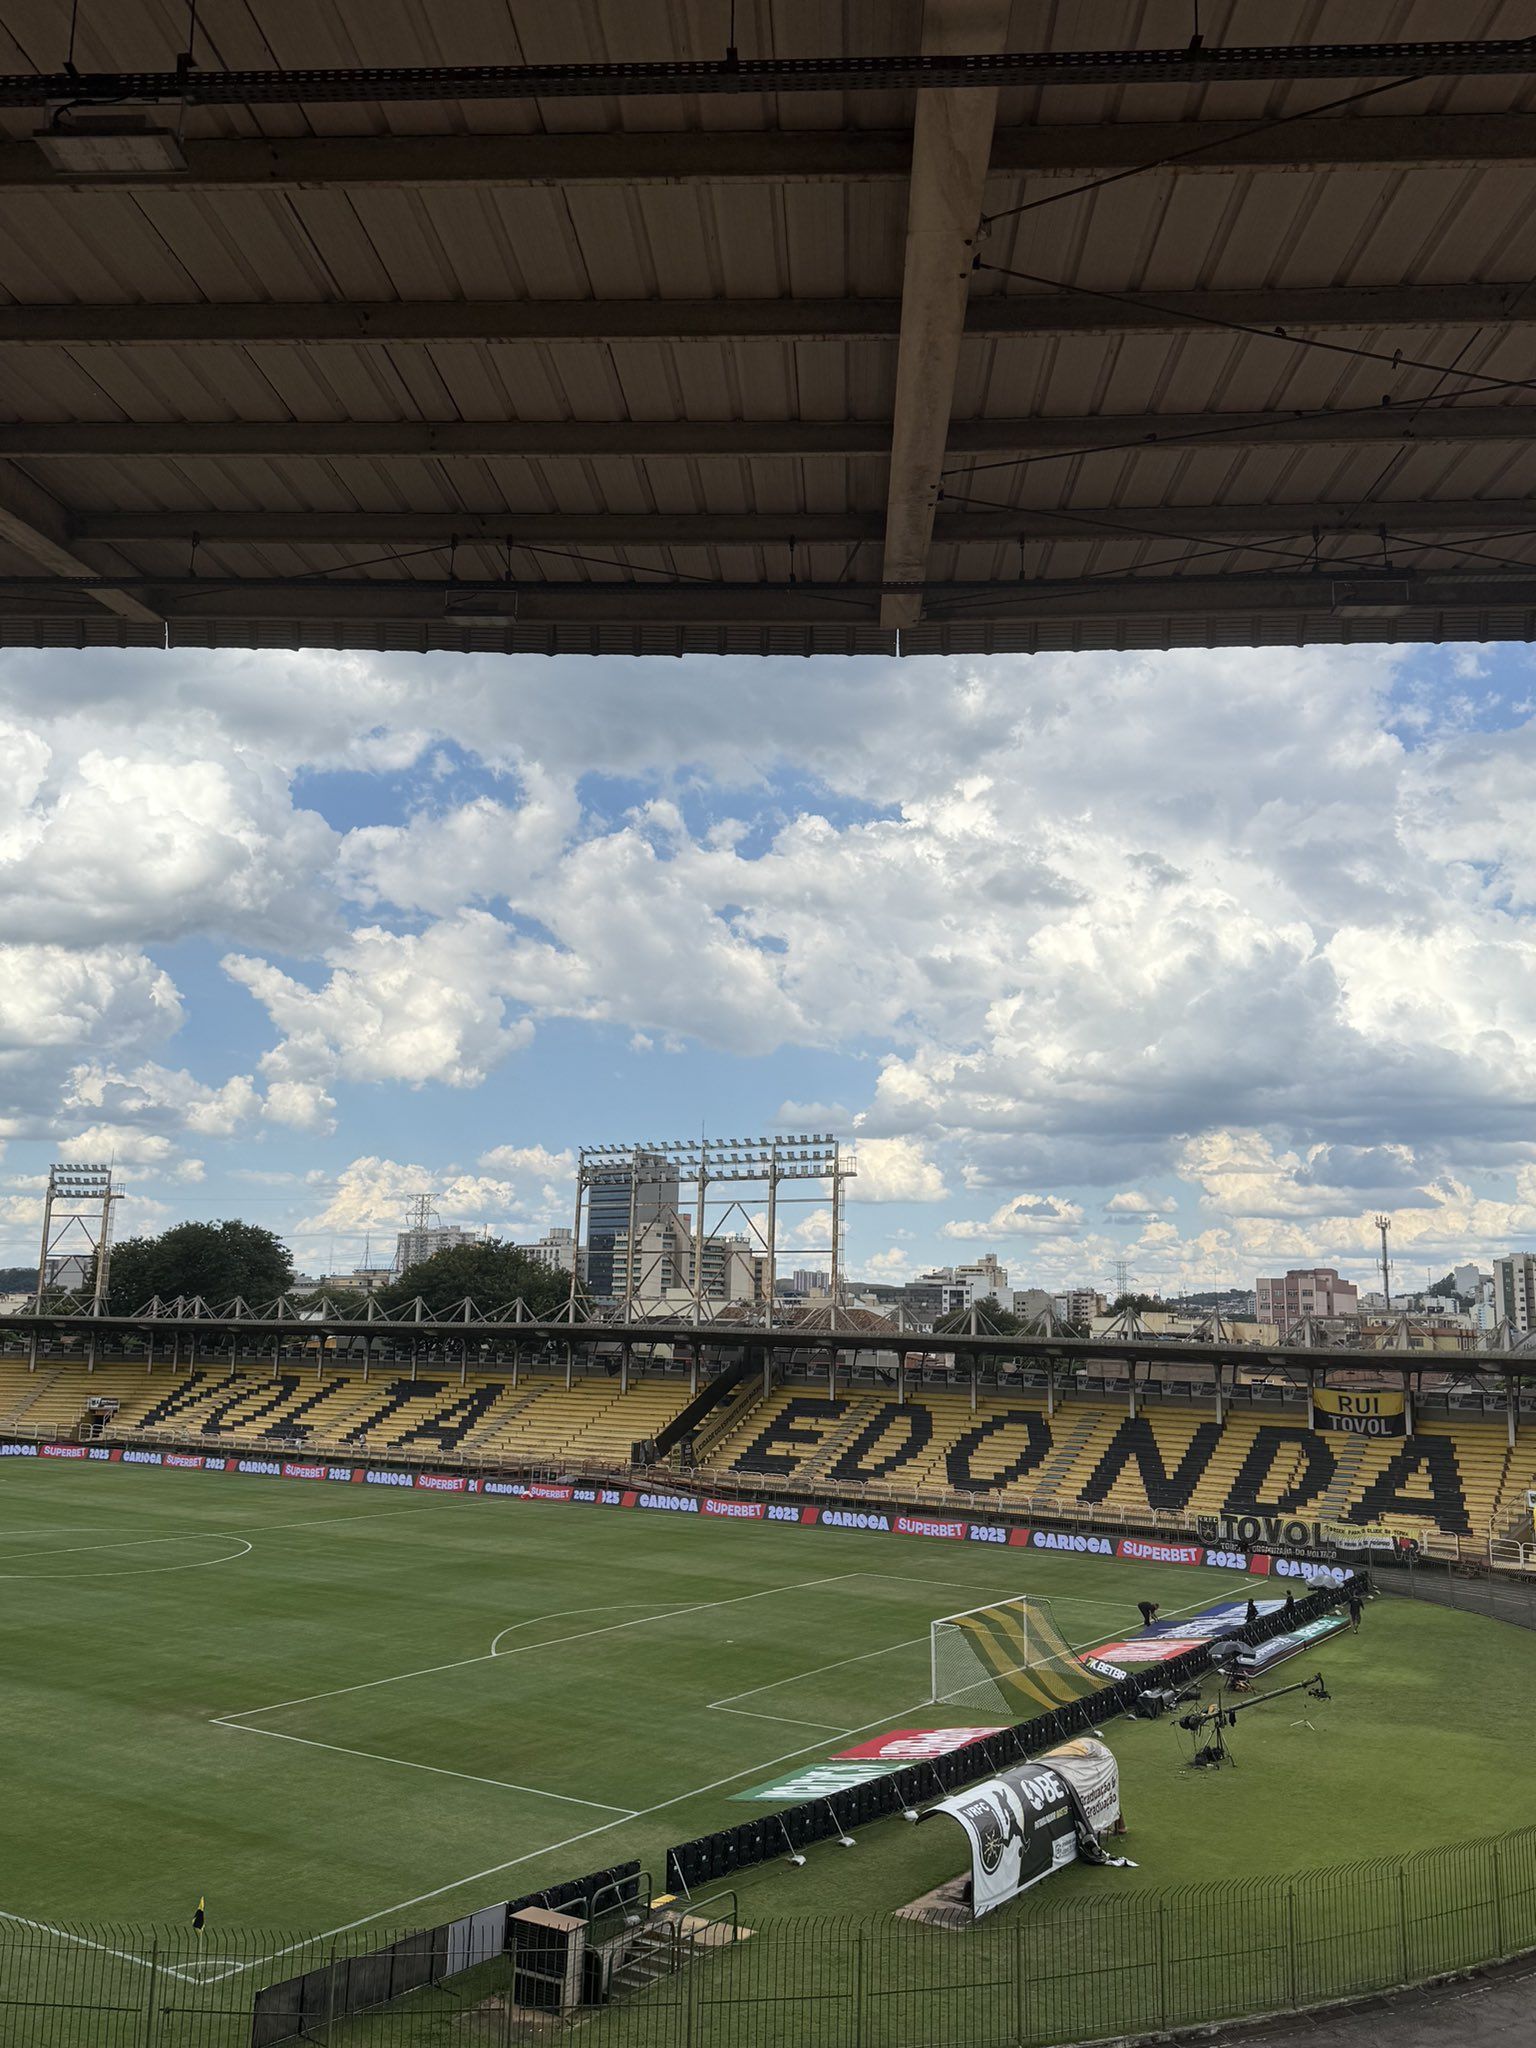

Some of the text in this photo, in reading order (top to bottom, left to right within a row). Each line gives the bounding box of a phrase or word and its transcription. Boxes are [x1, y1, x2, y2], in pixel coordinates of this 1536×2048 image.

[1338, 1395, 1379, 1414] RUI
[1328, 1414, 1392, 1435] TOVOL
[43, 1445, 86, 1458] SUPERBET
[89, 1448, 110, 1460] 2025
[123, 1451, 225, 1470] CARIOCA SUPERBET 2025
[239, 1460, 351, 1481] CARIOCA SUPERBET 2025
[366, 1471, 413, 1487] CARIOCA
[419, 1475, 466, 1491] SUPERBET
[485, 1482, 595, 1501] CARIOCA SUPERBET 2025
[640, 1493, 799, 1522] CARIOCA SUPERBET 2025
[822, 1510, 1007, 1544] CARIOCA SUPERBET 2025
[1220, 1514, 1335, 1549] TOVOL
[1033, 1531, 1248, 1570] CARIOCA SUPERBET 2025
[962, 1802, 990, 1818] VRFC
